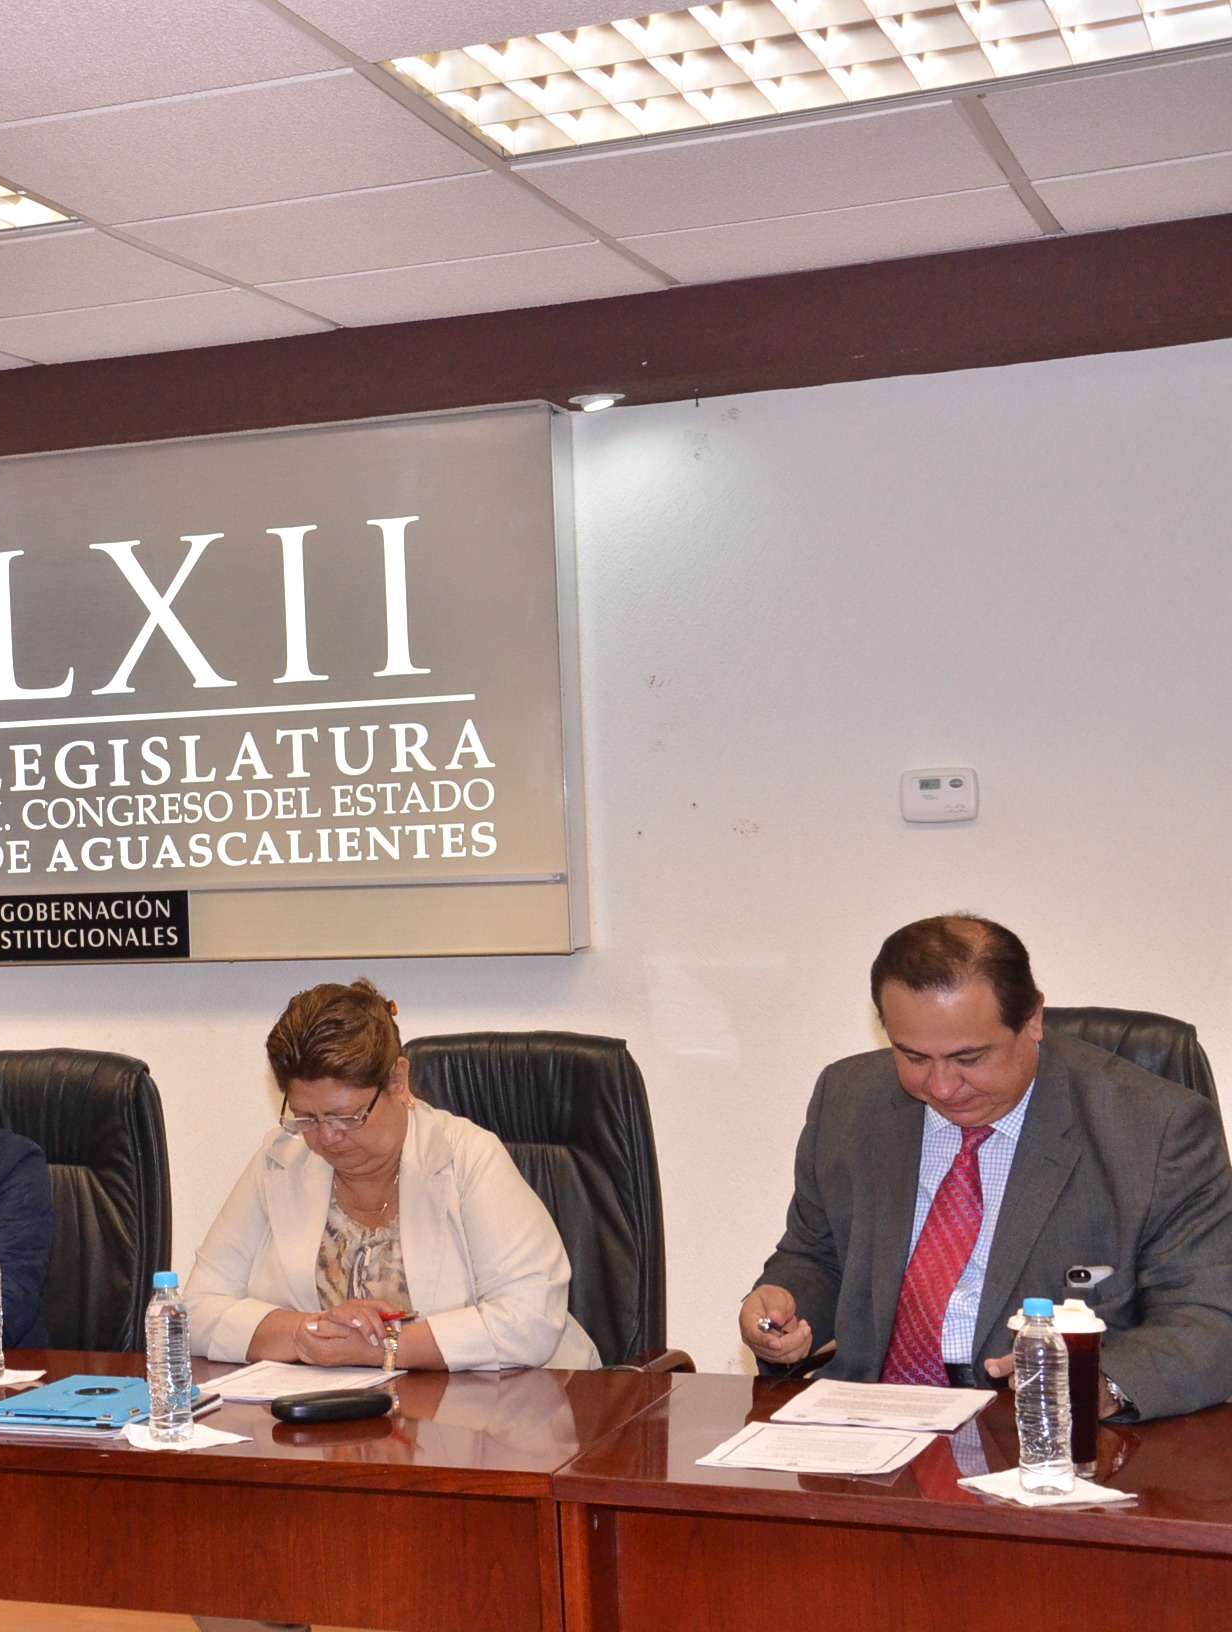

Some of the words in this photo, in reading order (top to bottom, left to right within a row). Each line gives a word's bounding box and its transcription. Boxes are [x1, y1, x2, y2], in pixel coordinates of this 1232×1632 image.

[22, 790, 233, 830] CONGRESO
[243, 787, 322, 821] DEL
[330, 778, 495, 817] ESTADO
[45, 821, 498, 872] AGUASCALIENTES
[0, 896, 171, 923] GOBERNACIÓN
